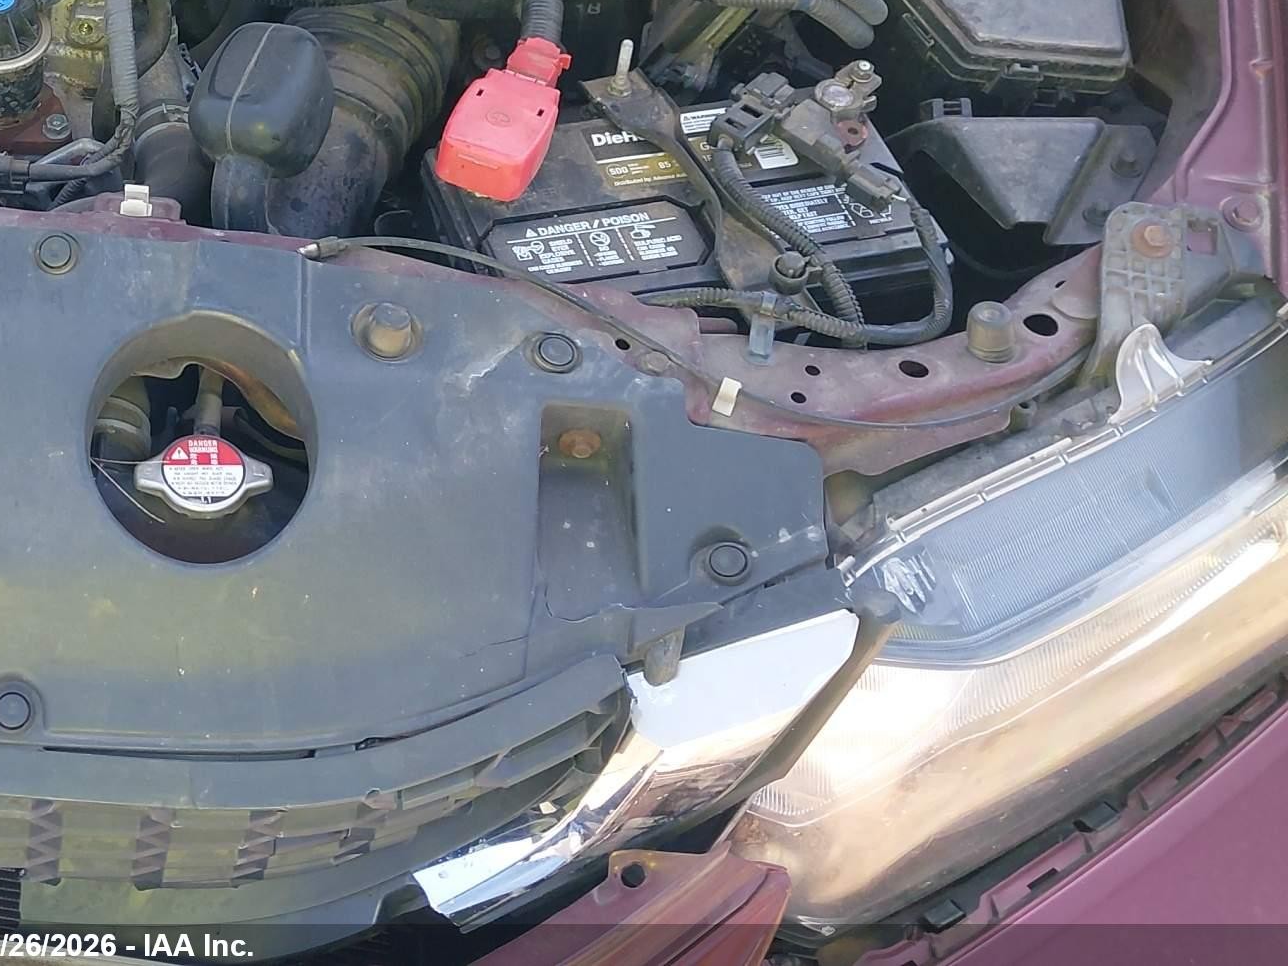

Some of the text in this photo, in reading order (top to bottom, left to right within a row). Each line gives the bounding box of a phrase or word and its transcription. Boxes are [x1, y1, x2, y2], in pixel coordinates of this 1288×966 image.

[591, 131, 646, 147] DieH
[609, 166, 629, 176] 500
[537, 221, 590, 236] DANGER
[603, 212, 650, 228] POISON
[188, 439, 218, 447] DANGER
